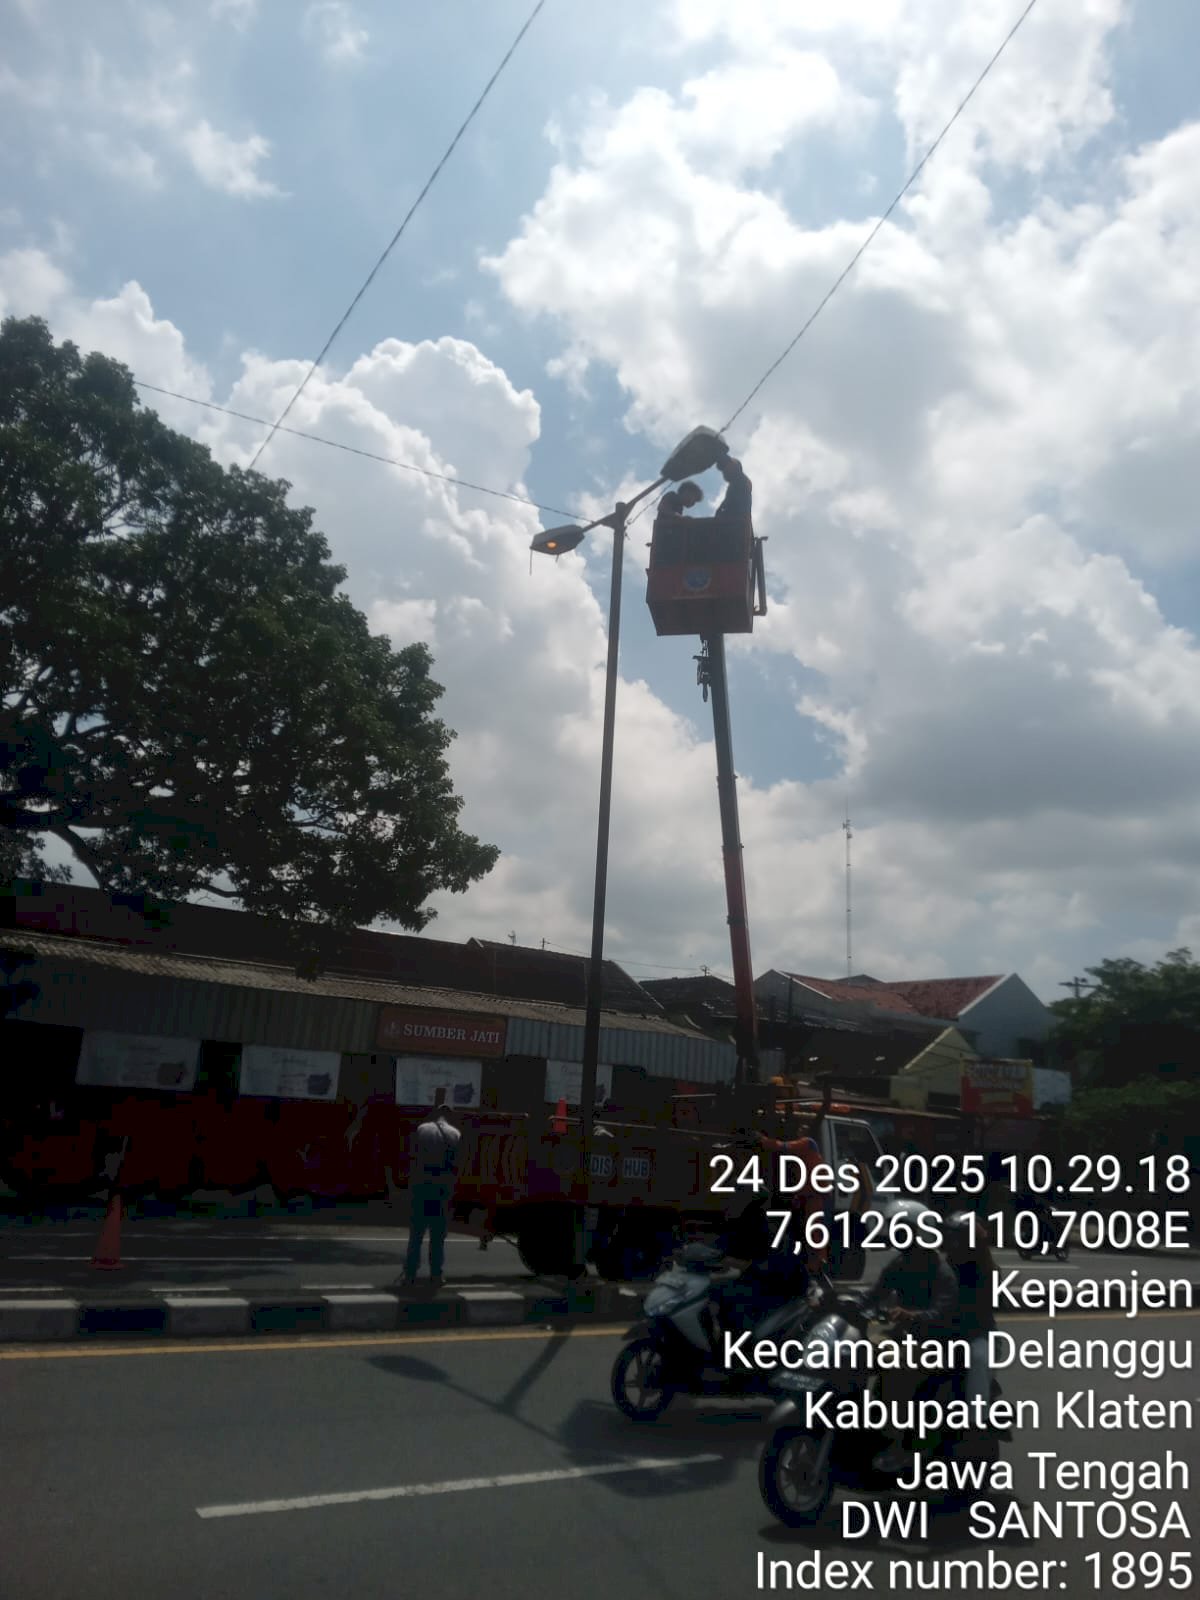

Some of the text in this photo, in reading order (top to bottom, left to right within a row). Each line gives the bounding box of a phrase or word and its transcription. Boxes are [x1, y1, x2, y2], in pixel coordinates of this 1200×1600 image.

[403, 1023, 500, 1043] SUMBER JATI
[591, 1156, 649, 1177] DIS HUB
